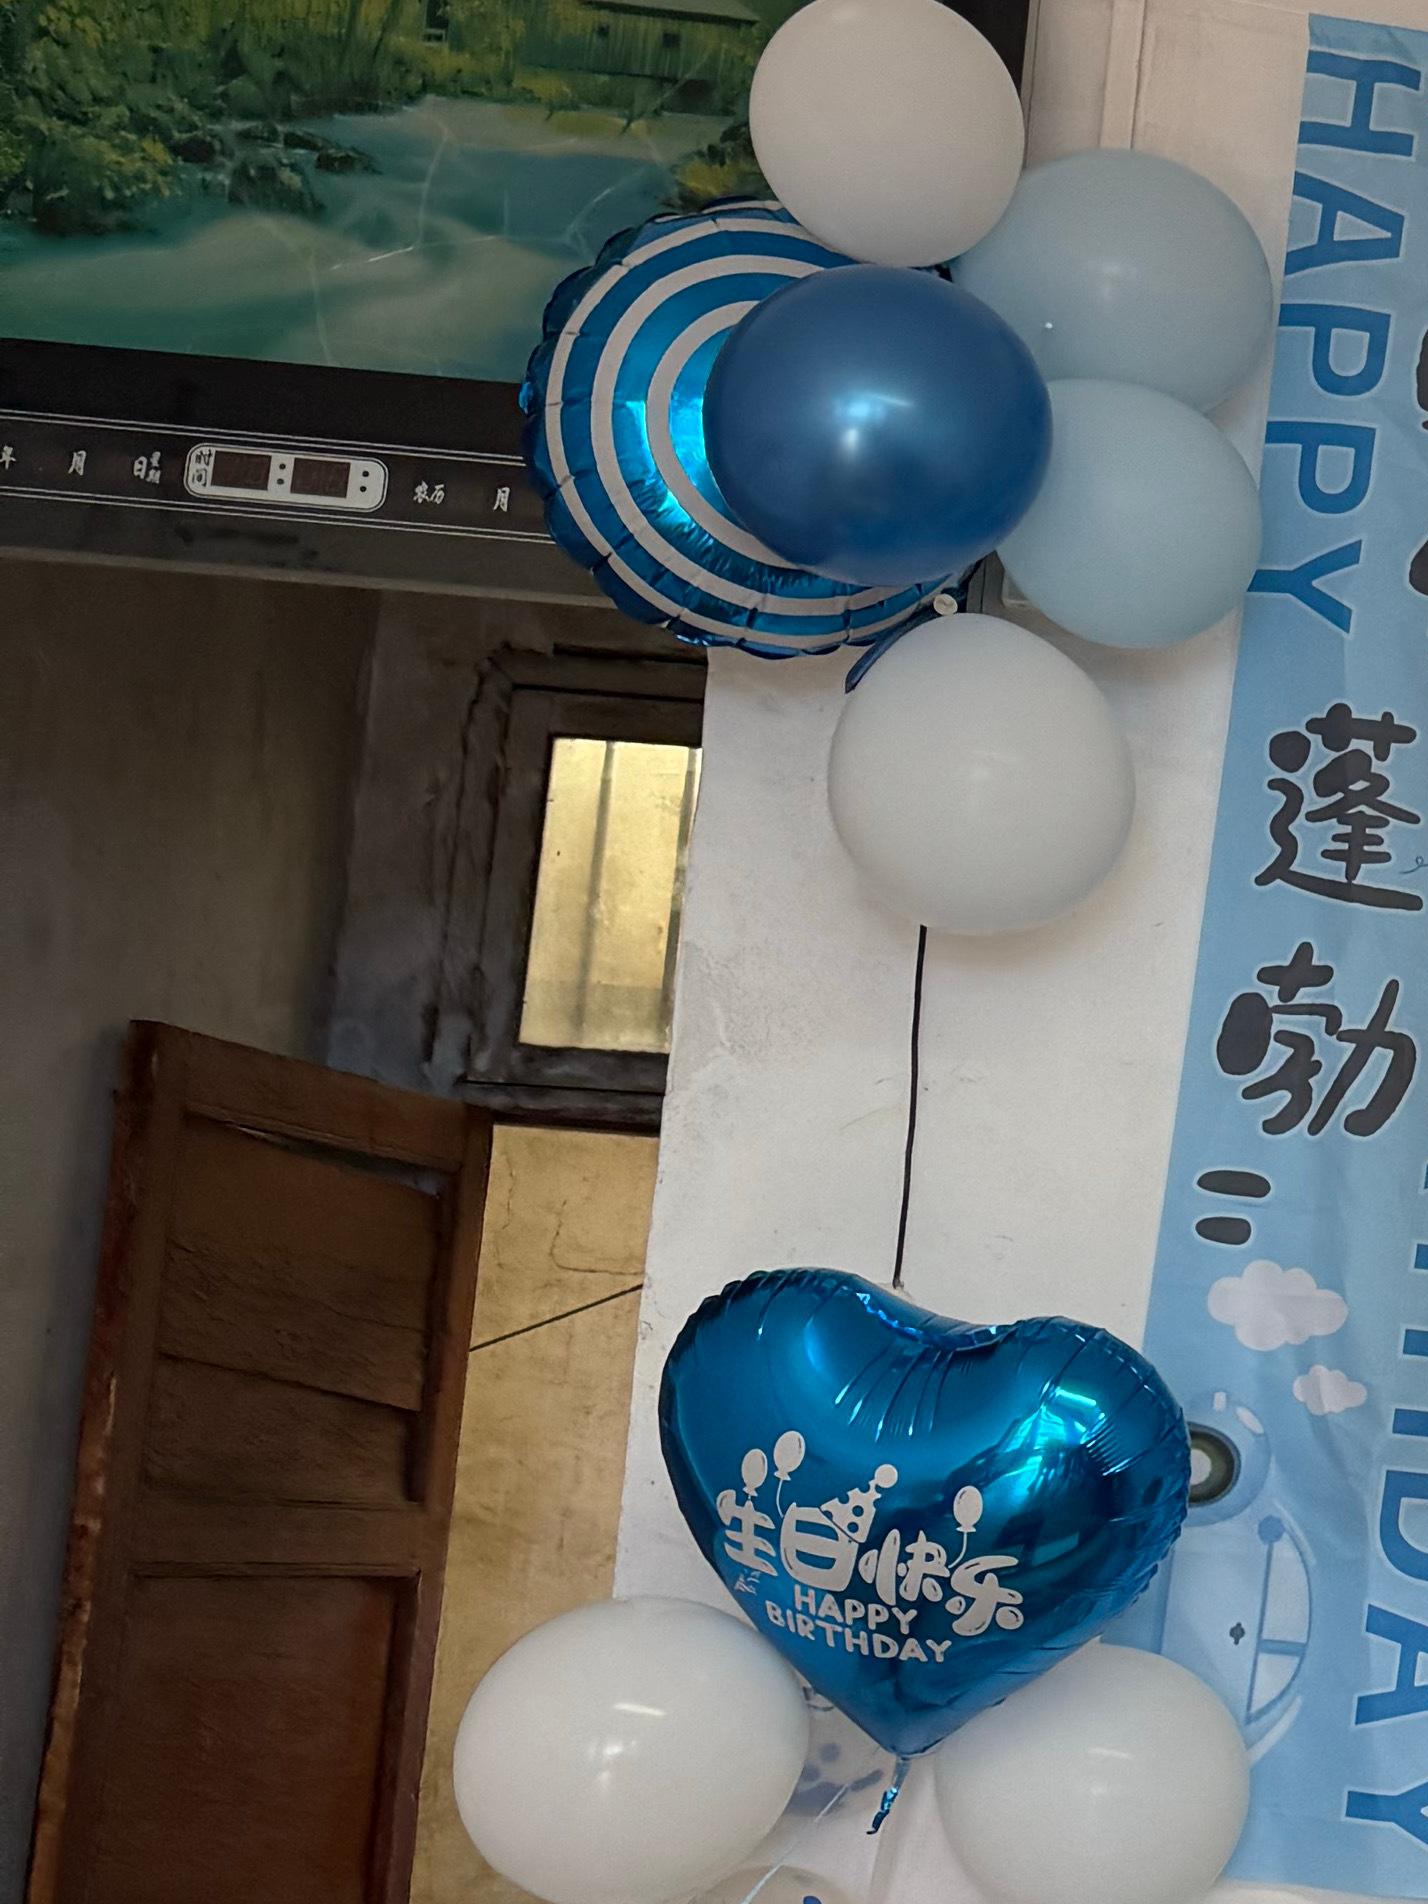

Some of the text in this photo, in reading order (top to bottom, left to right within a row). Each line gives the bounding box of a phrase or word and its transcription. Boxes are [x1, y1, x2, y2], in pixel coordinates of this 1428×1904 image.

[1248, 49, 1423, 635] HAPPY
[68, 450, 87, 476] 月
[493, 486, 511, 512] 月
[716, 1489, 1025, 1636] 生日快乐
[764, 1600, 952, 1663] BIRTHDAY
[793, 1585, 920, 1636] HAPPY
